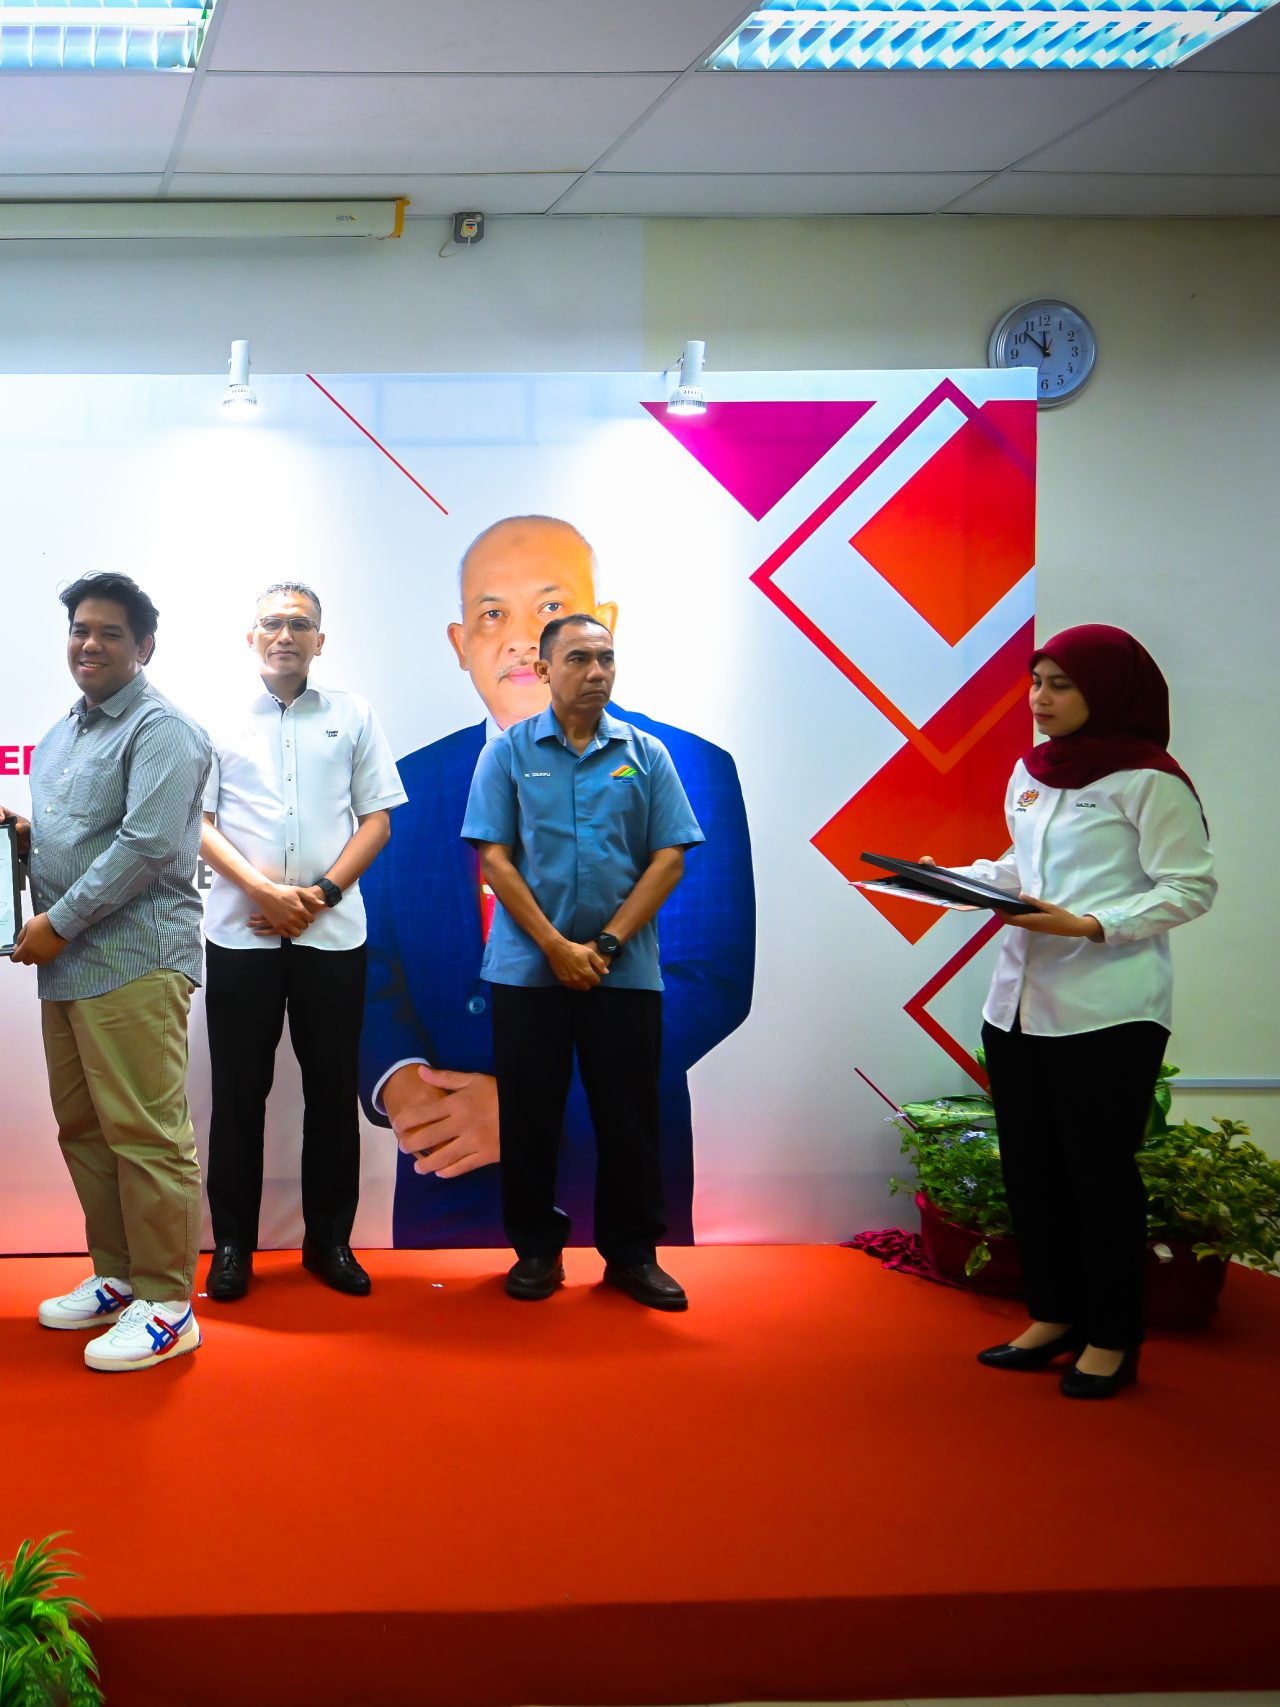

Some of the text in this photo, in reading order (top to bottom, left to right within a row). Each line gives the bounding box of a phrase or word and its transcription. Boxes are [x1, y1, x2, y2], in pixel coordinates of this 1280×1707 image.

[1025, 321, 1034, 331] 11
[1039, 315, 1051, 326] 12
[1058, 320, 1062, 331] 1
[1014, 334, 1027, 345] 10
[1067, 331, 1075, 342] 2
[1010, 349, 1019, 359] 9
[1071, 346, 1078, 357] 3
[1067, 362, 1073, 374] 4
[1041, 379, 1049, 390] 6
[1057, 375, 1064, 386] 5
